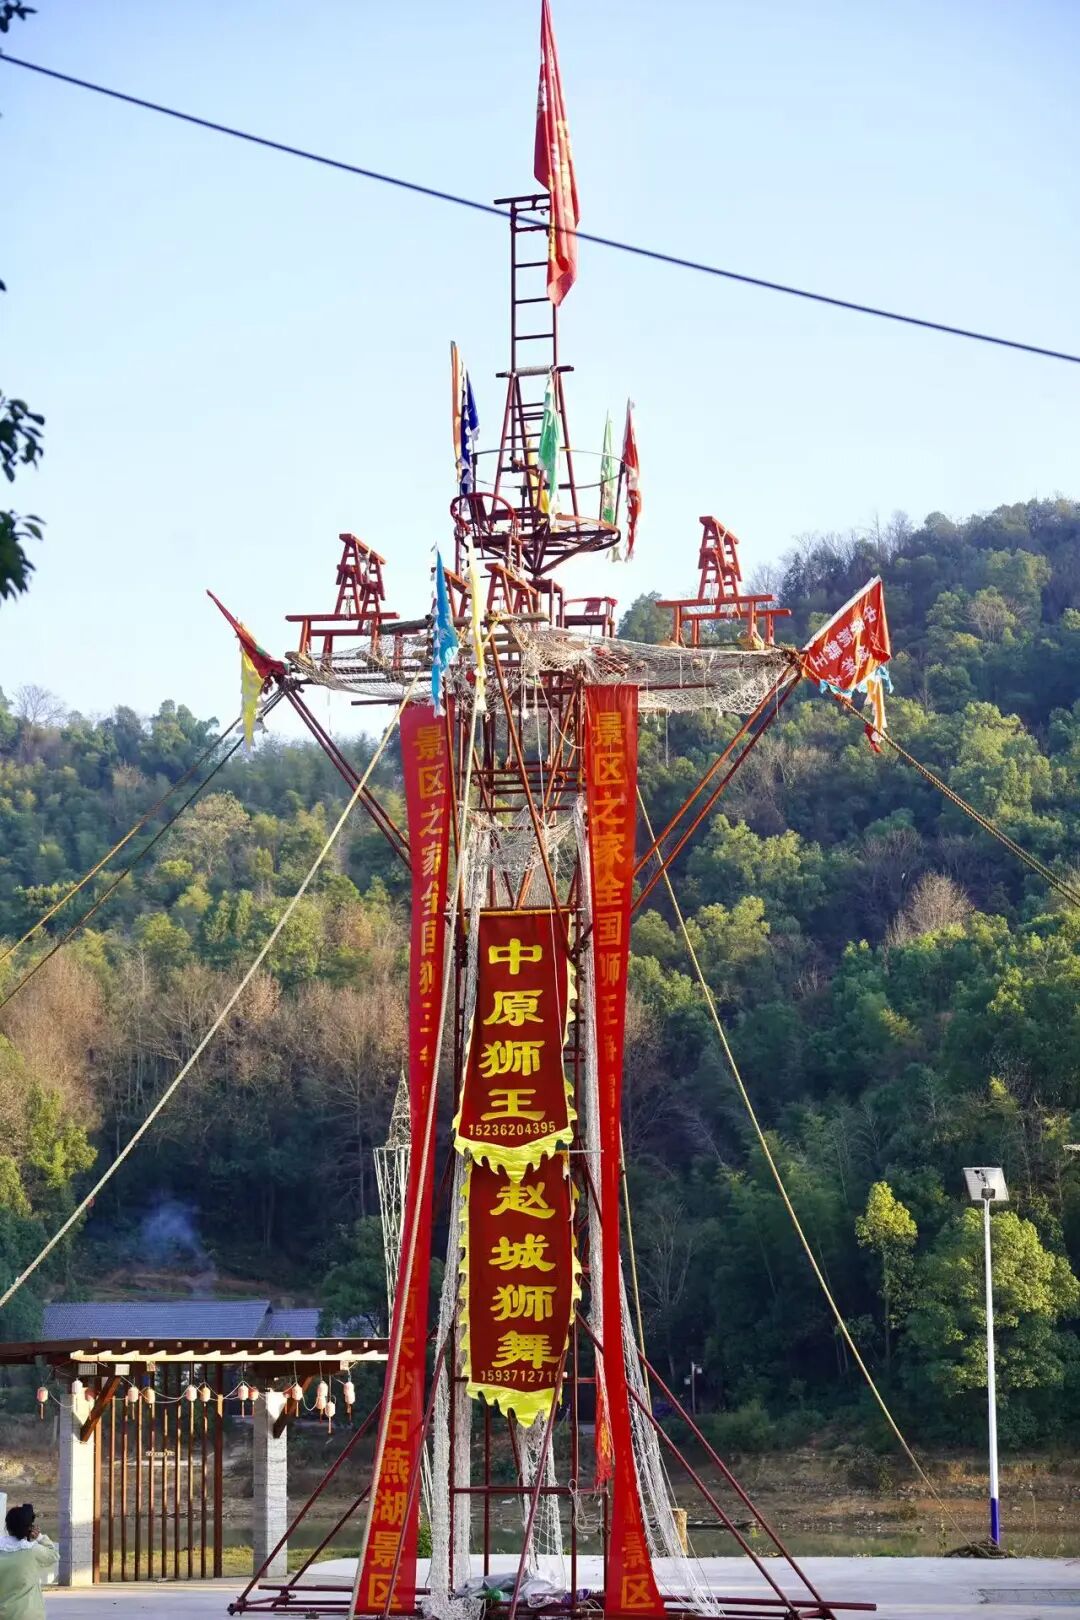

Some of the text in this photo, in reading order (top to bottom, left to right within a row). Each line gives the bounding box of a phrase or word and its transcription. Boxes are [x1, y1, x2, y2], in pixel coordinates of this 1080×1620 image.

[478, 937, 546, 1121] 中原狮王
[468, 1121, 556, 1136] 15236204395
[489, 1180, 561, 1370] 赵城狮舞
